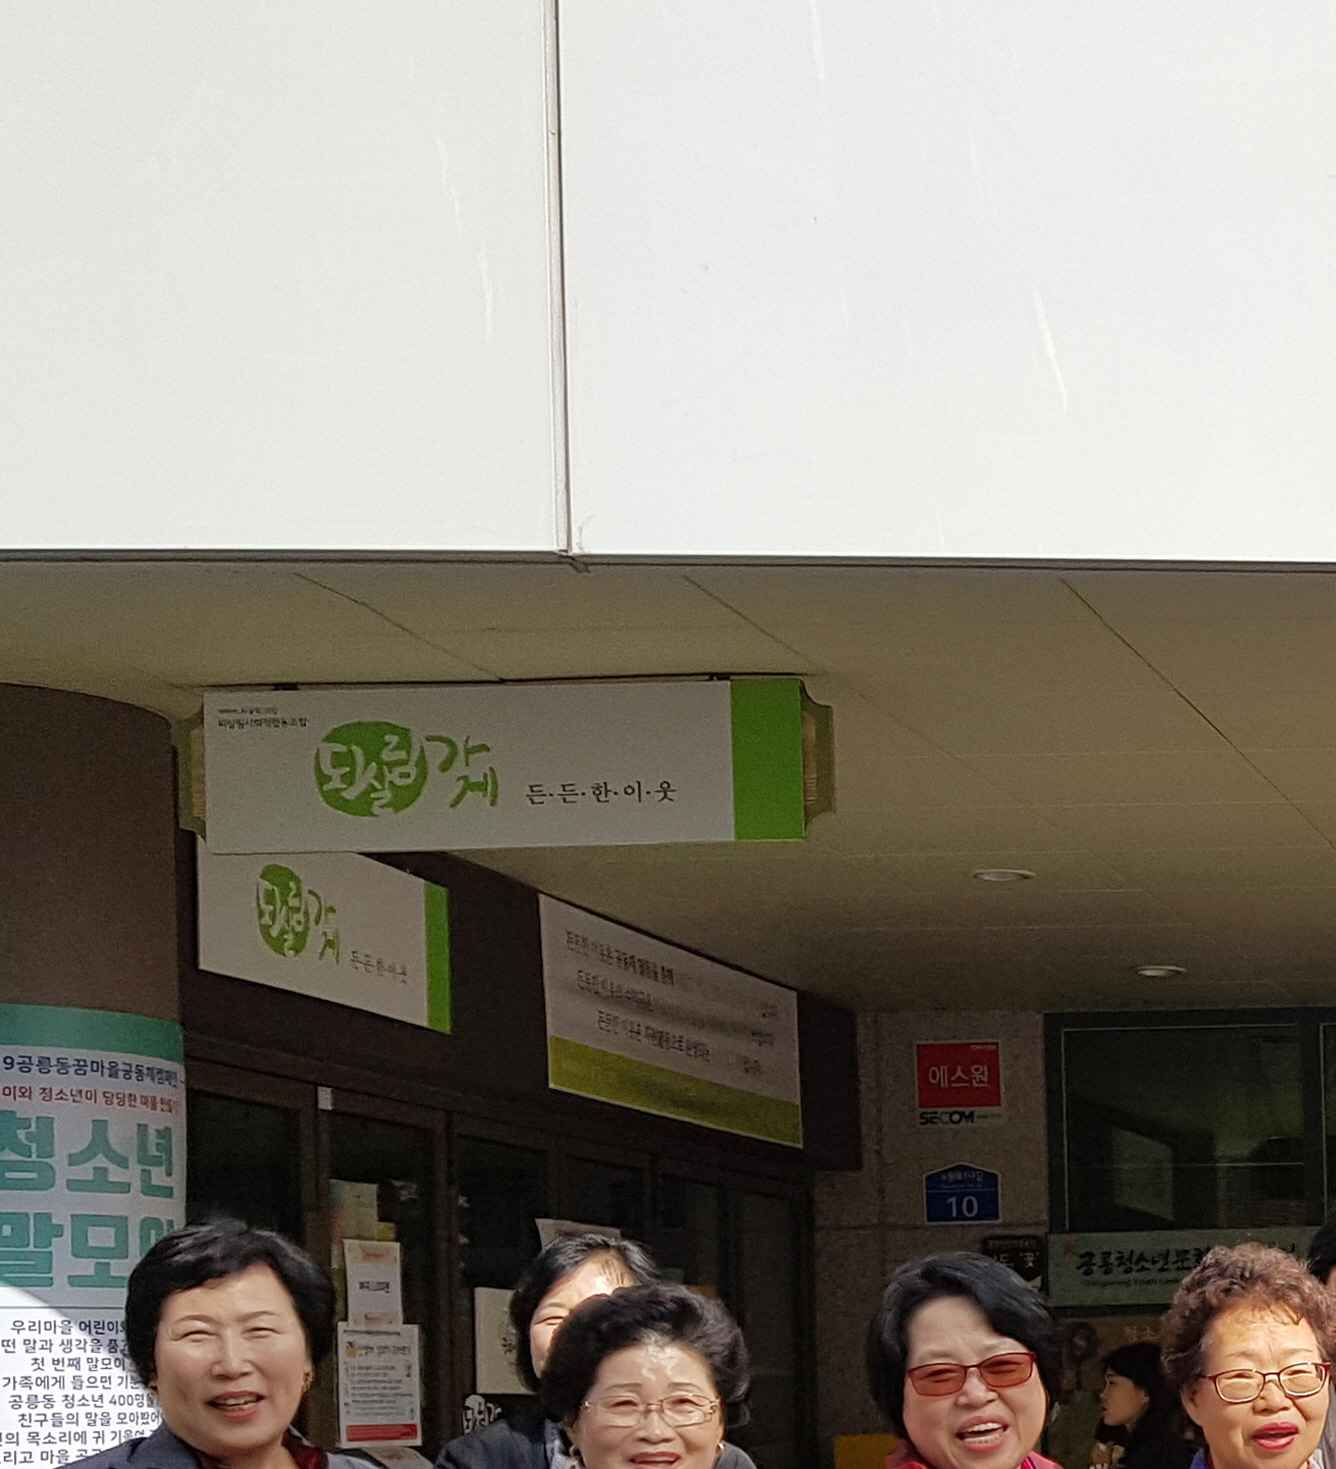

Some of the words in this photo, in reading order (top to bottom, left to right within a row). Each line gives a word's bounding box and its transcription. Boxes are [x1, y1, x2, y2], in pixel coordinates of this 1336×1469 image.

[928, 1064, 990, 1088] 에스원
[39, 1086, 97, 1104] 청소년이
[919, 1110, 975, 1125] SECOM
[0, 1109, 174, 1199] 청소년
[946, 1195, 979, 1218] 10
[11, 1319, 74, 1335] 우리마을
[22, 1338, 54, 1354] 말과
[58, 1338, 103, 1354] 생각을
[30, 1357, 46, 1372] 첫
[51, 1357, 82, 1372] 번째
[2, 1375, 66, 1390] 가족에게
[71, 1375, 112, 1390] 들으면
[8, 1394, 56, 1410] 공릉동
[62, 1393, 105, 1410] 청소년
[18, 1412, 80, 1428] 친구들의
[85, 1411, 112, 1427] 말을
[26, 1431, 87, 1447] 목소리에
[92, 1431, 105, 1445] 귀
[0, 1450, 35, 1465] 리고
[40, 1450, 70, 1465] 마을
